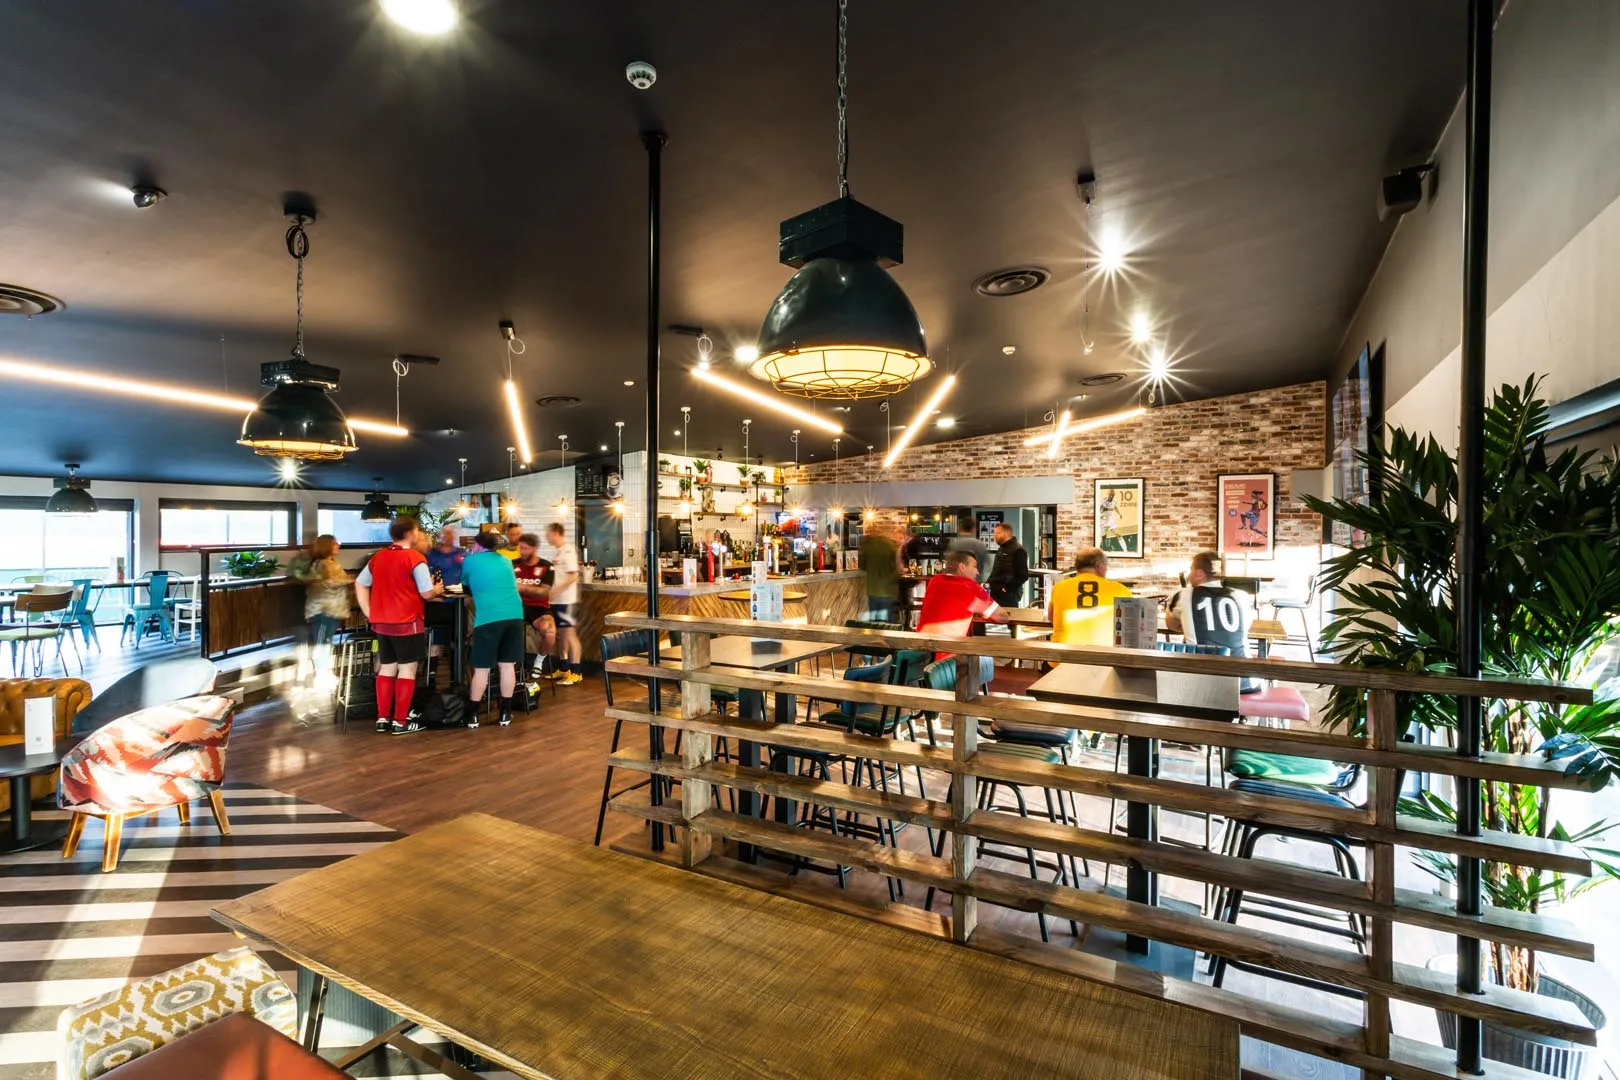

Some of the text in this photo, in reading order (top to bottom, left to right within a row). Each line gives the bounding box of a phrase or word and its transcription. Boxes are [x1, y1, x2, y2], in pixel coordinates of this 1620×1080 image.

[1120, 490, 1133, 501] 10
[1076, 581, 1098, 609] 8
[1197, 597, 1240, 633] 10
